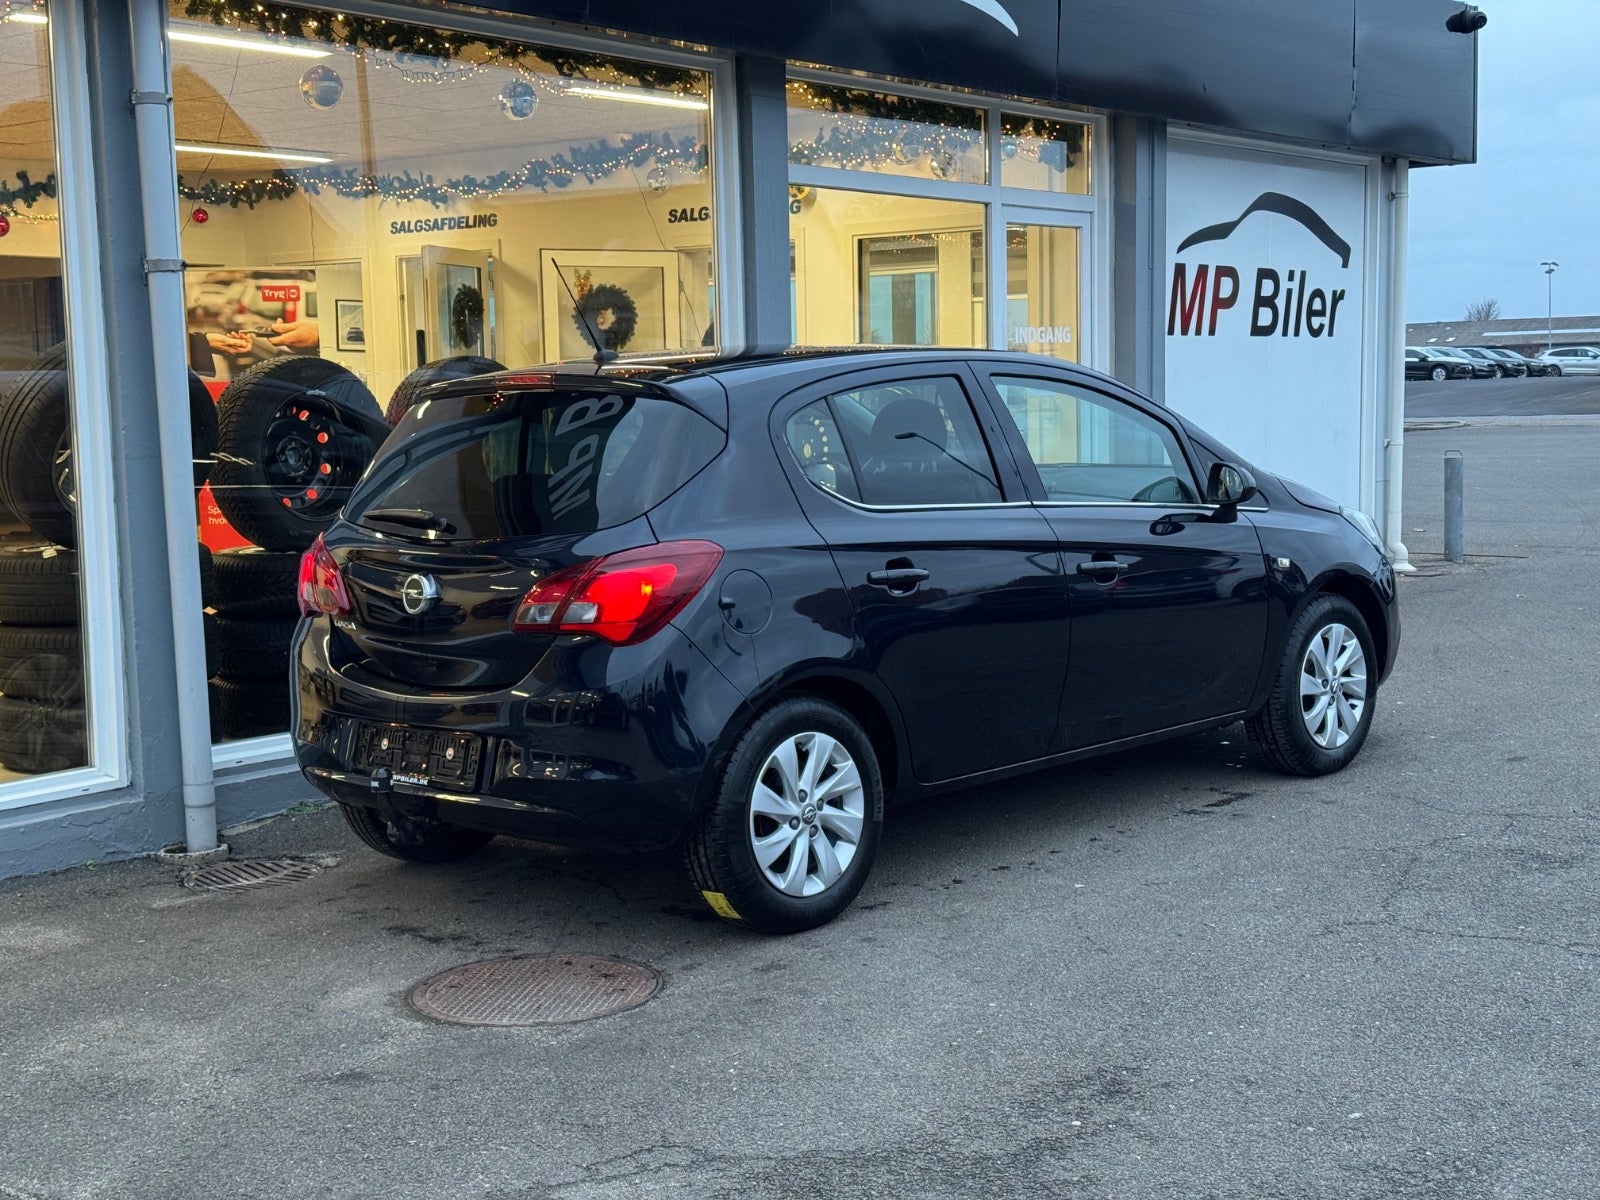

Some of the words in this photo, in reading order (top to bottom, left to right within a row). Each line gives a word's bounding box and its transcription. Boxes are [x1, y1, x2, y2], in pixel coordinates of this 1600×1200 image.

[390, 213, 498, 235] SALGSAFDELING
[668, 206, 711, 224] SALG
[263, 289, 286, 300] Tryg
[1167, 262, 1240, 336] MP
[1249, 267, 1346, 338] Biler
[1014, 326, 1072, 344] INDGANG
